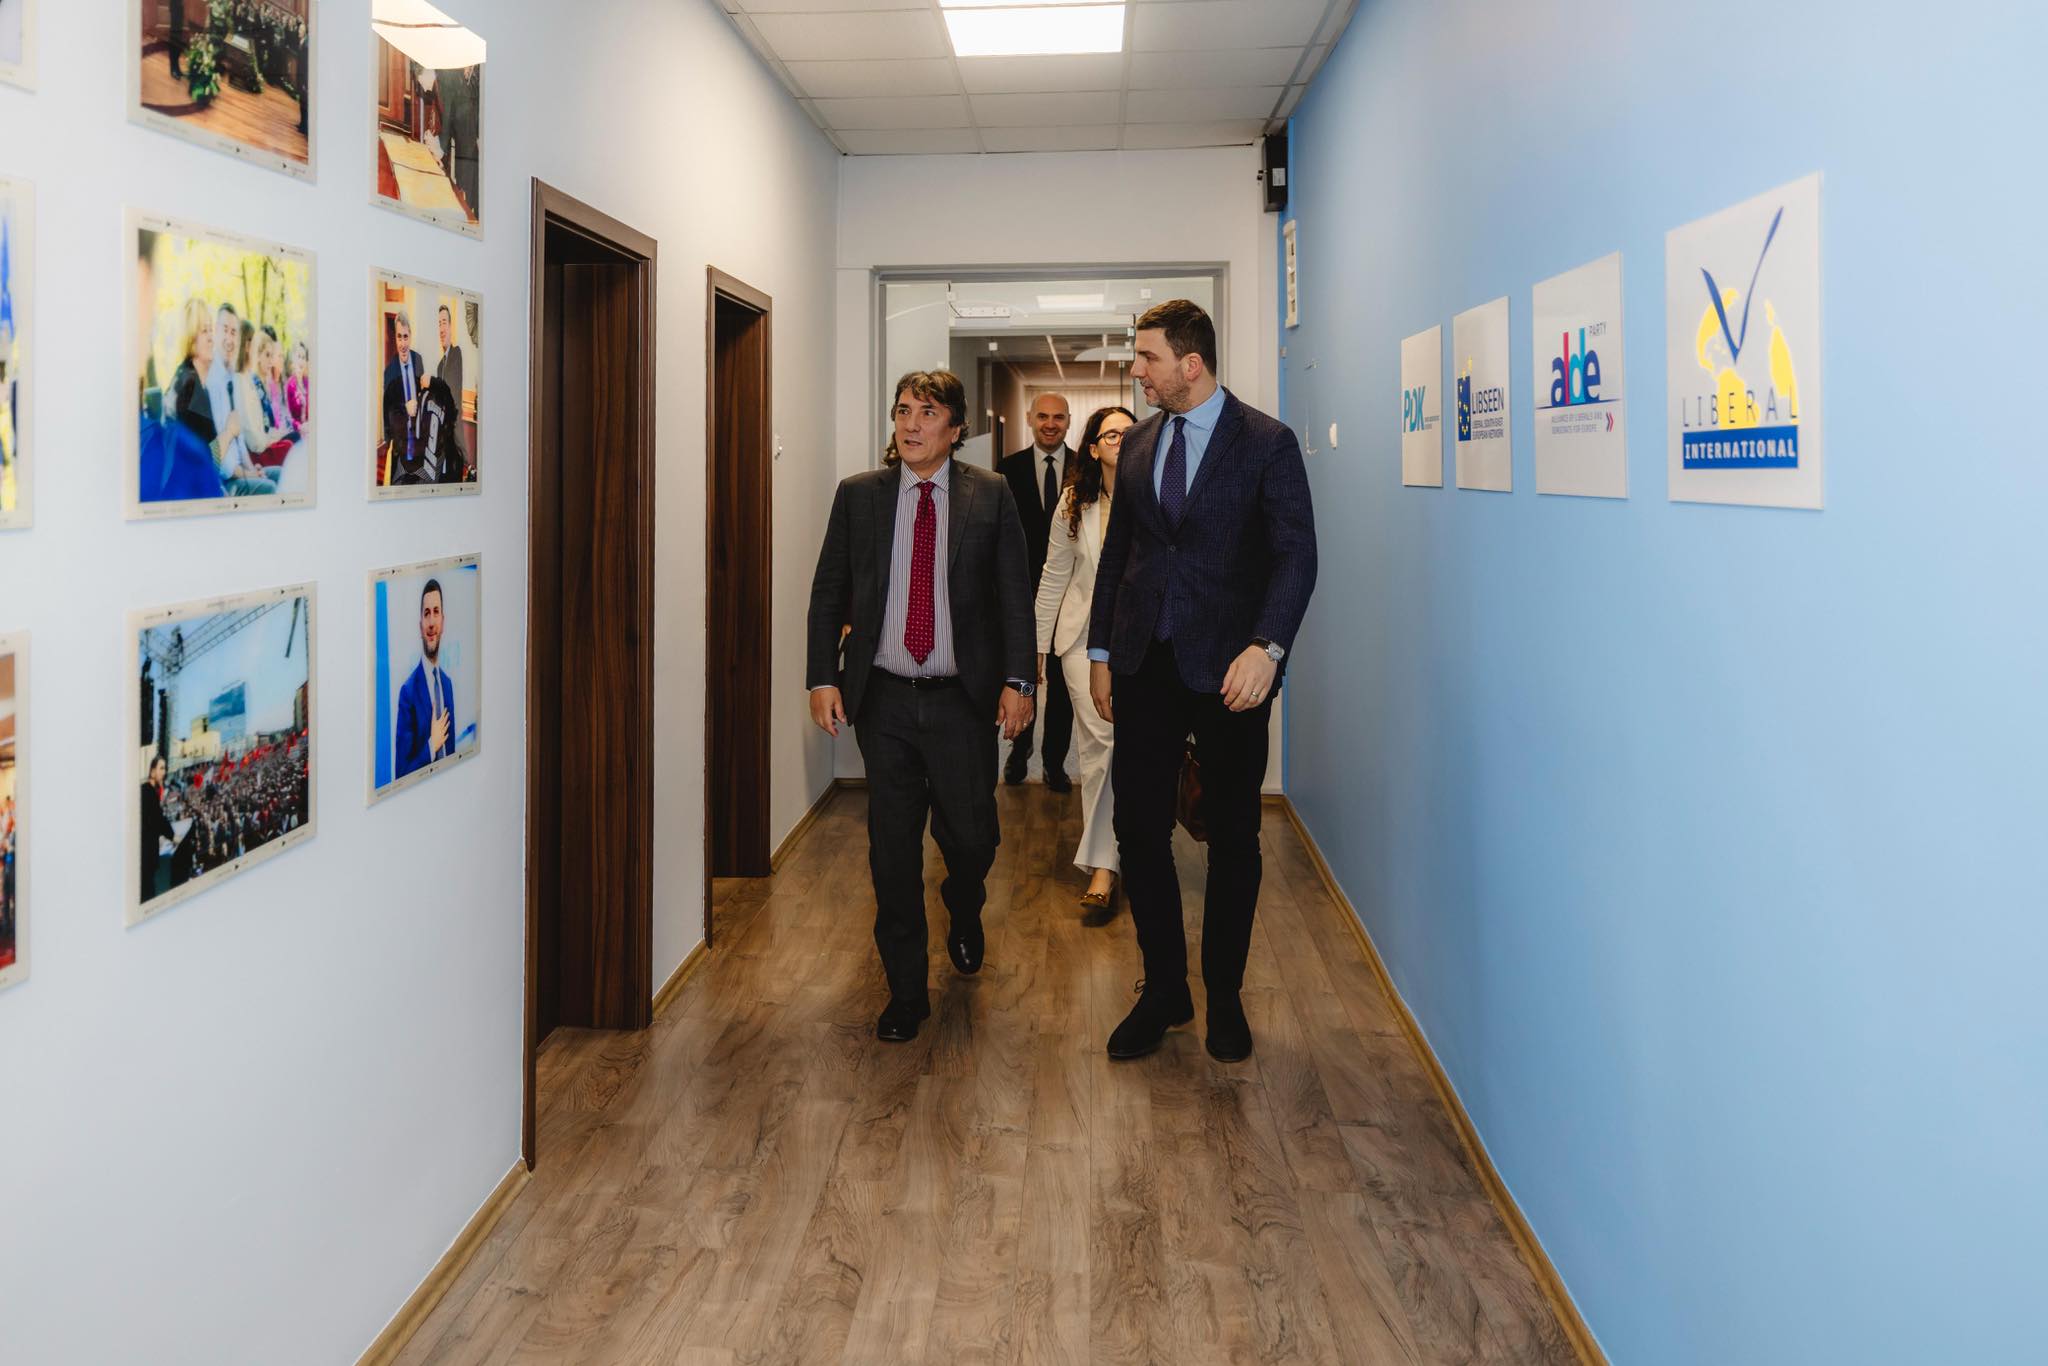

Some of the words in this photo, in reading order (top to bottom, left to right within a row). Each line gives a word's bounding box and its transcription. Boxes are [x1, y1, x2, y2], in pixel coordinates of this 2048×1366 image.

[1588, 321, 1607, 336] PARTY
[1551, 327, 1600, 407] alde
[1403, 385, 1425, 432] PDK
[1472, 387, 1504, 414] LIBSEEN
[1682, 384, 1797, 427] LIBERAL
[1685, 438, 1796, 460] INTERNATIONAL
